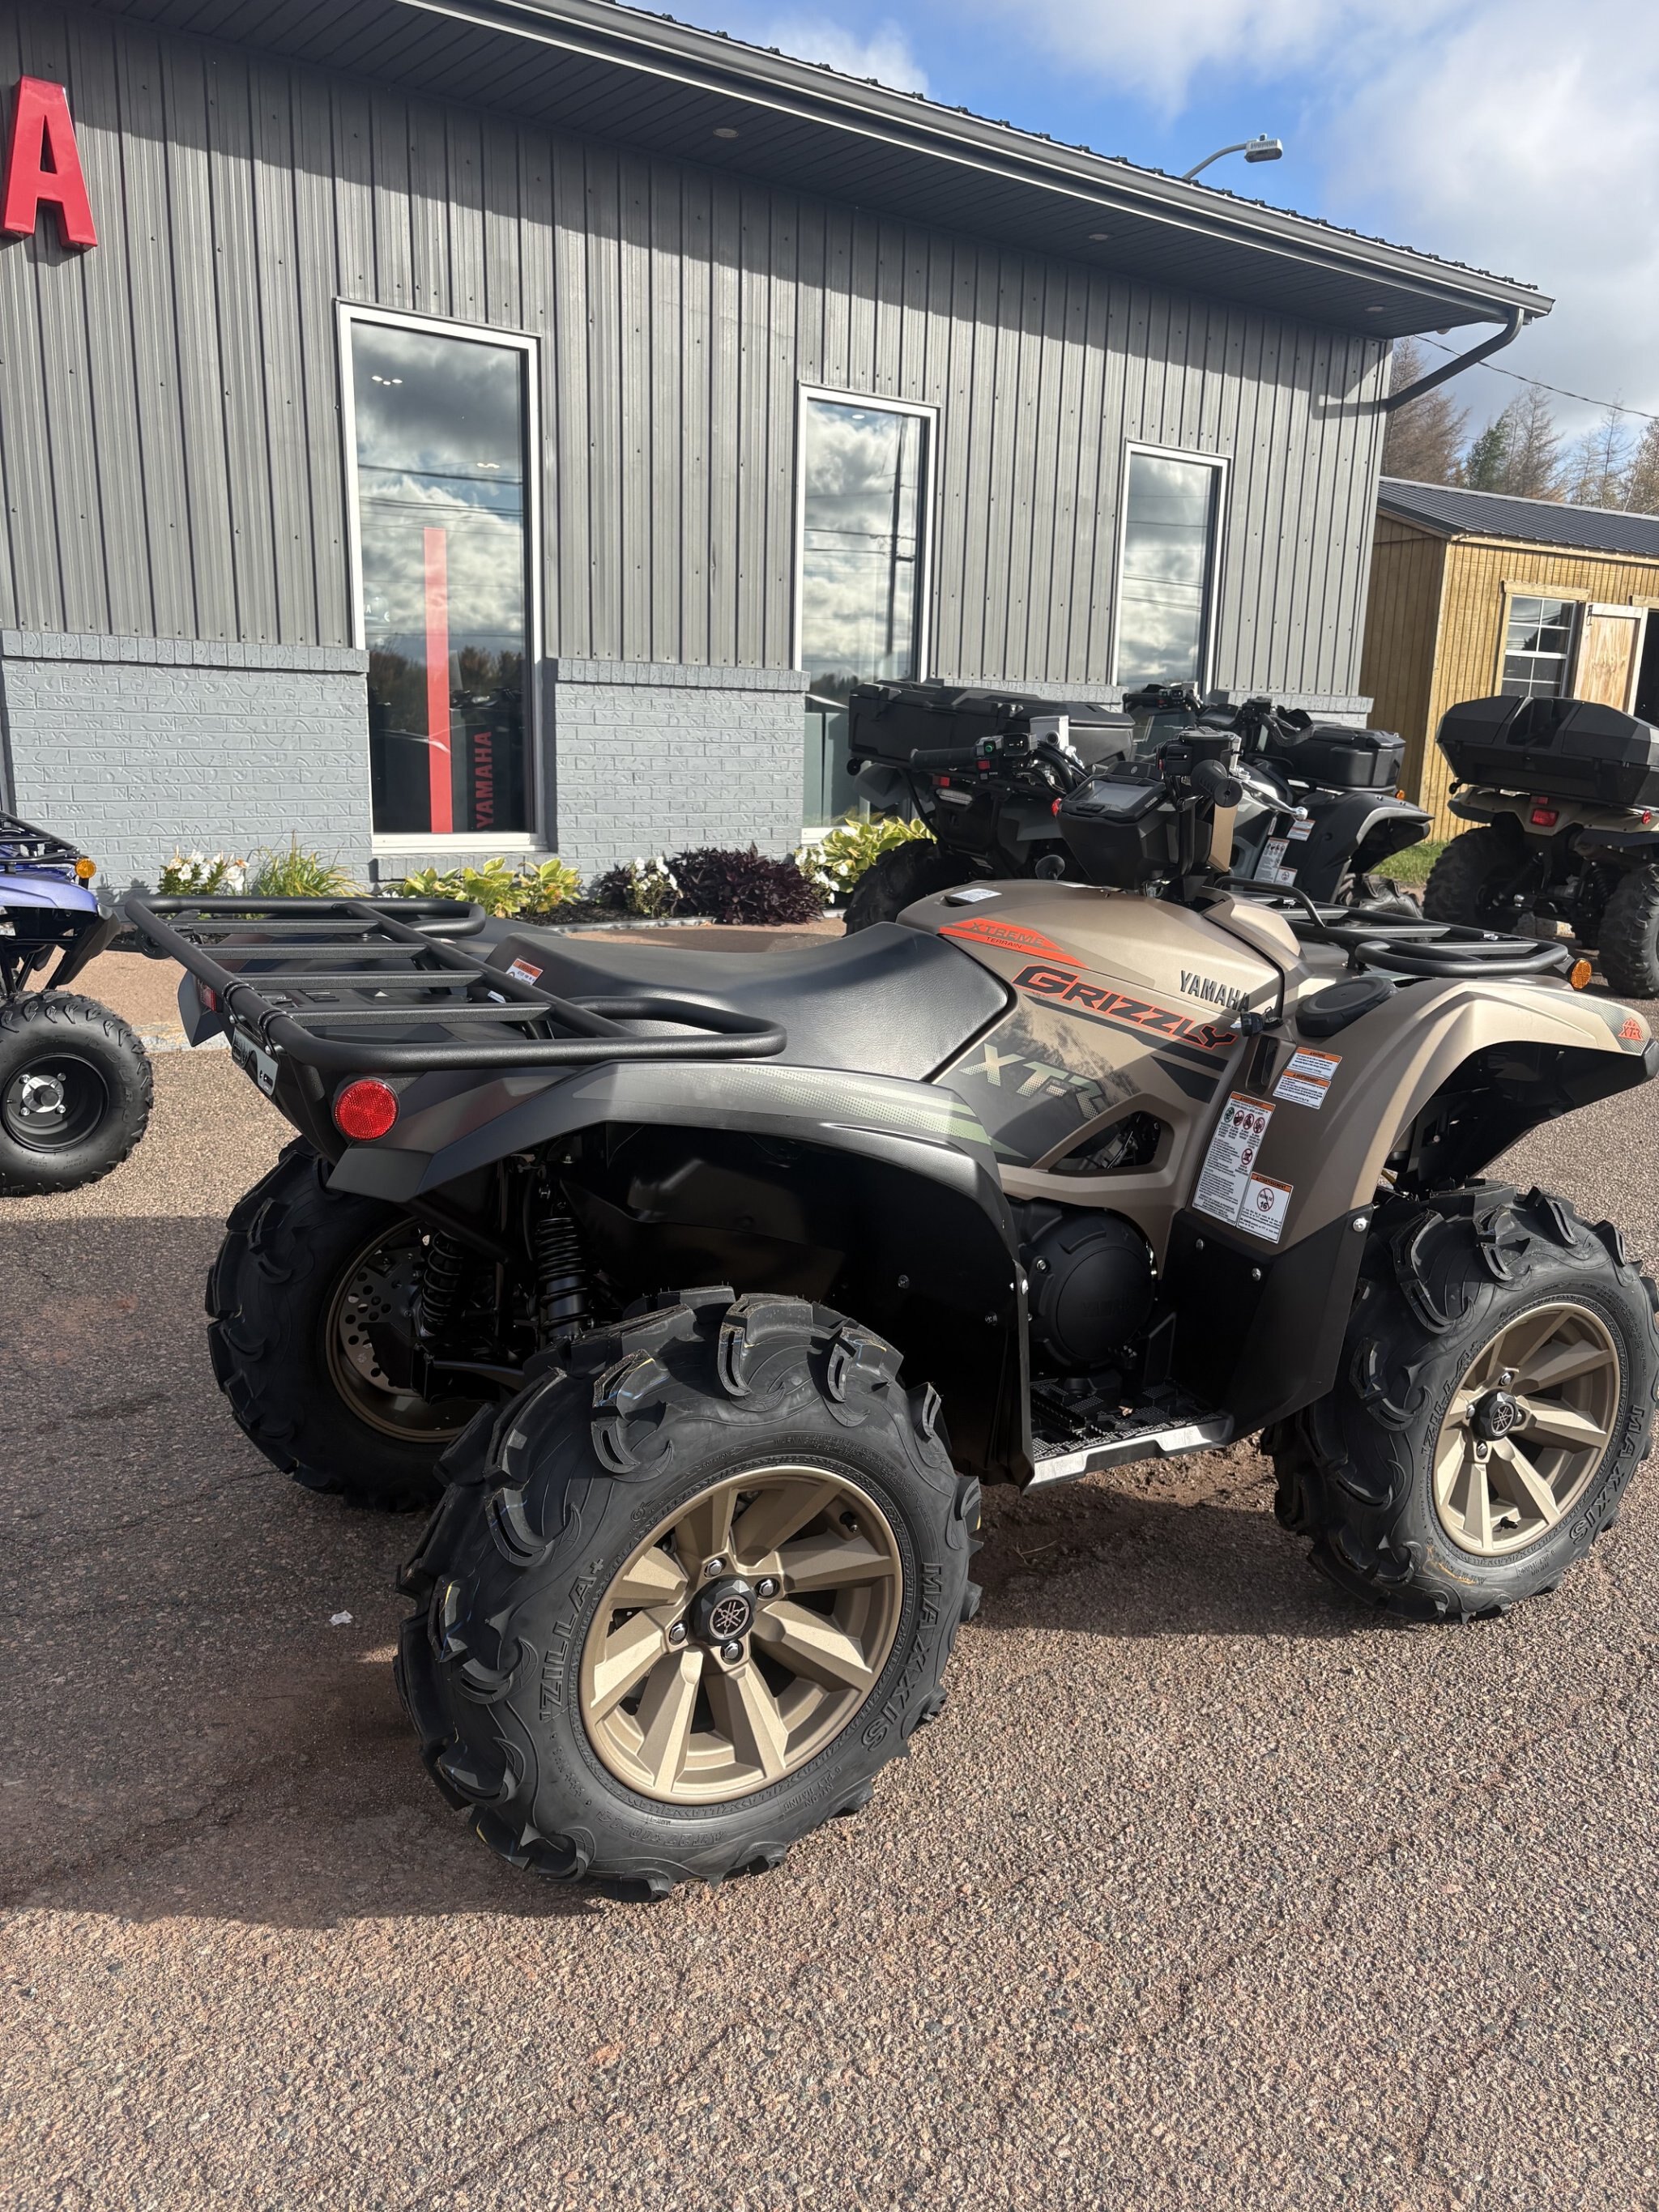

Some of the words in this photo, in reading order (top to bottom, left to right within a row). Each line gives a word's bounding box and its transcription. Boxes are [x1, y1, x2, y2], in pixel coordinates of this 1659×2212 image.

[3, 75, 98, 249] A
[474, 731, 494, 829] YAMAHA
[971, 922, 1045, 946] XTREME
[986, 936, 1022, 949] TERRAIN
[1011, 963, 1239, 1050] GRIZZLY
[1179, 970, 1251, 1012] YAMAHA
[1260, 1201, 1269, 1209] 16
[1569, 1404, 1645, 1545] MAXXIS
[862, 1562, 944, 1752] MAXXIS
[804, 1783, 834, 1808] NYLON
[817, 1771, 836, 1790] PLY
[783, 1787, 815, 1812] RATING
